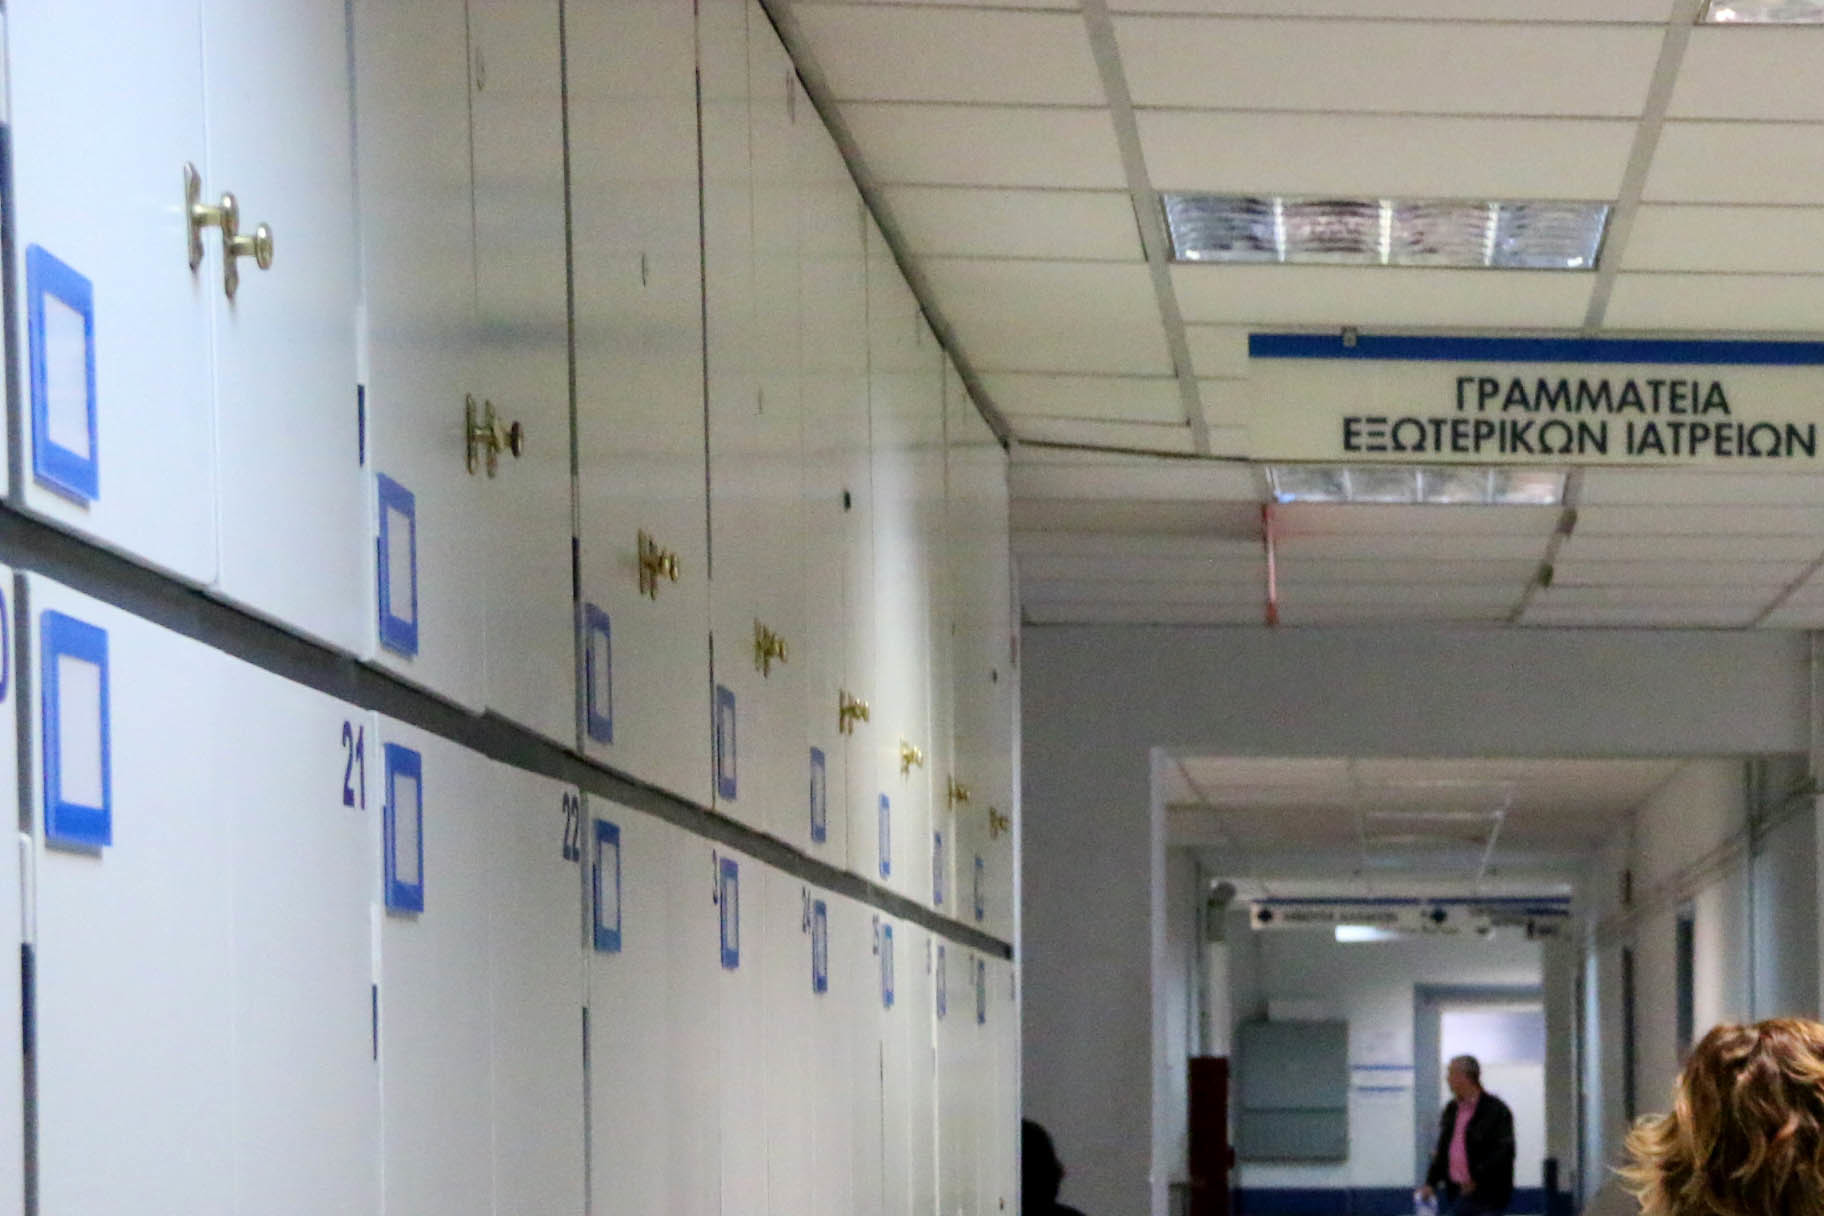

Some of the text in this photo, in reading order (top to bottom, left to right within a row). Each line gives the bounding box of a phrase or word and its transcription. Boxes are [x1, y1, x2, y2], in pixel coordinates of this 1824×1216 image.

[1455, 375, 1732, 416] ΓΡΑΜΜΑΤΕΙΑ
[1341, 416, 1818, 459] ΕΞΩΤΕΡΙΚΩΝ ΙΑΤΡΕΙΩΝ
[342, 720, 366, 811] 21
[562, 791, 580, 863] 22
